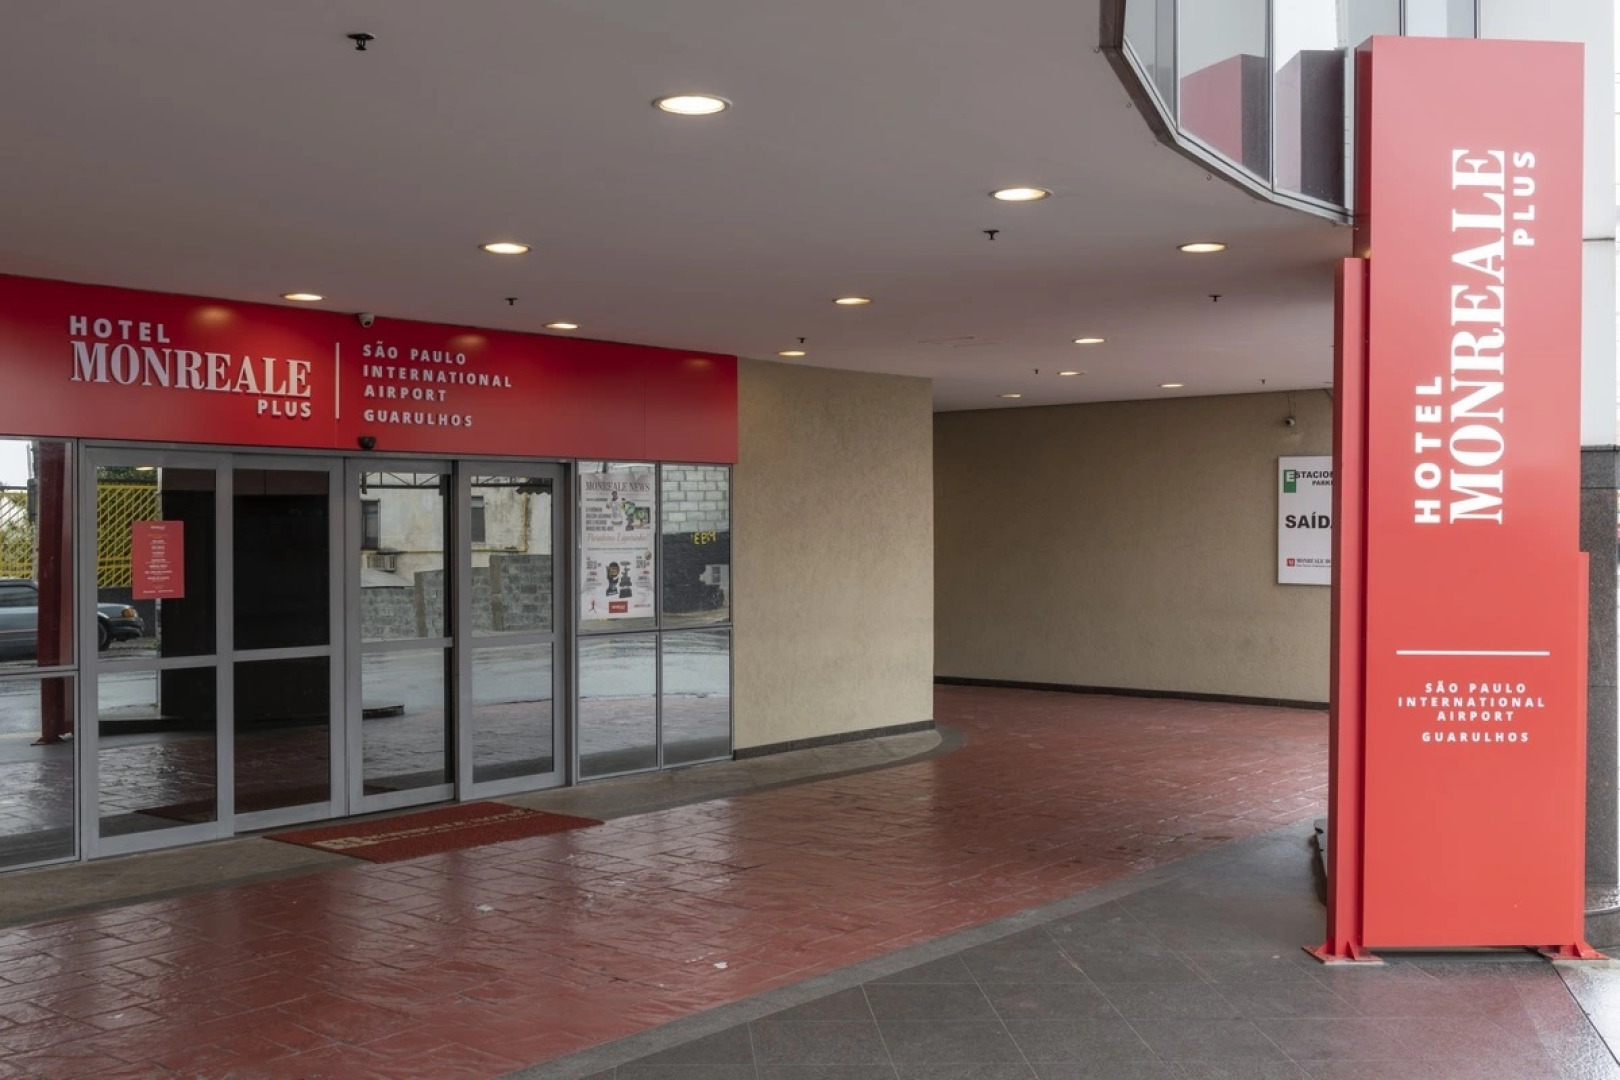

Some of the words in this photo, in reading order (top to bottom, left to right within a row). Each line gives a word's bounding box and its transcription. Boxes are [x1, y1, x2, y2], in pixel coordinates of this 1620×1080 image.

[1512, 151, 1536, 246] PLUS
[69, 315, 171, 344] HOTEL
[1449, 148, 1505, 525] MONREALE
[362, 340, 398, 359] SÃO
[410, 348, 467, 365] PAULO
[70, 340, 312, 398] MONREALE
[362, 364, 512, 388] INTERNATIONAL
[363, 384, 447, 402] AIRPORT
[257, 399, 312, 418] PLUS
[363, 409, 473, 428] GUARULHOS
[1414, 376, 1442, 524] HOTEL
[1285, 511, 1332, 529] SAÍD
[1425, 680, 1459, 693] SÃO
[1469, 683, 1527, 694] PAULO
[1398, 697, 1545, 708] INTERNATIONAL
[1436, 711, 1515, 722] AIRPORT
[1422, 732, 1529, 743] GUARULHOS
